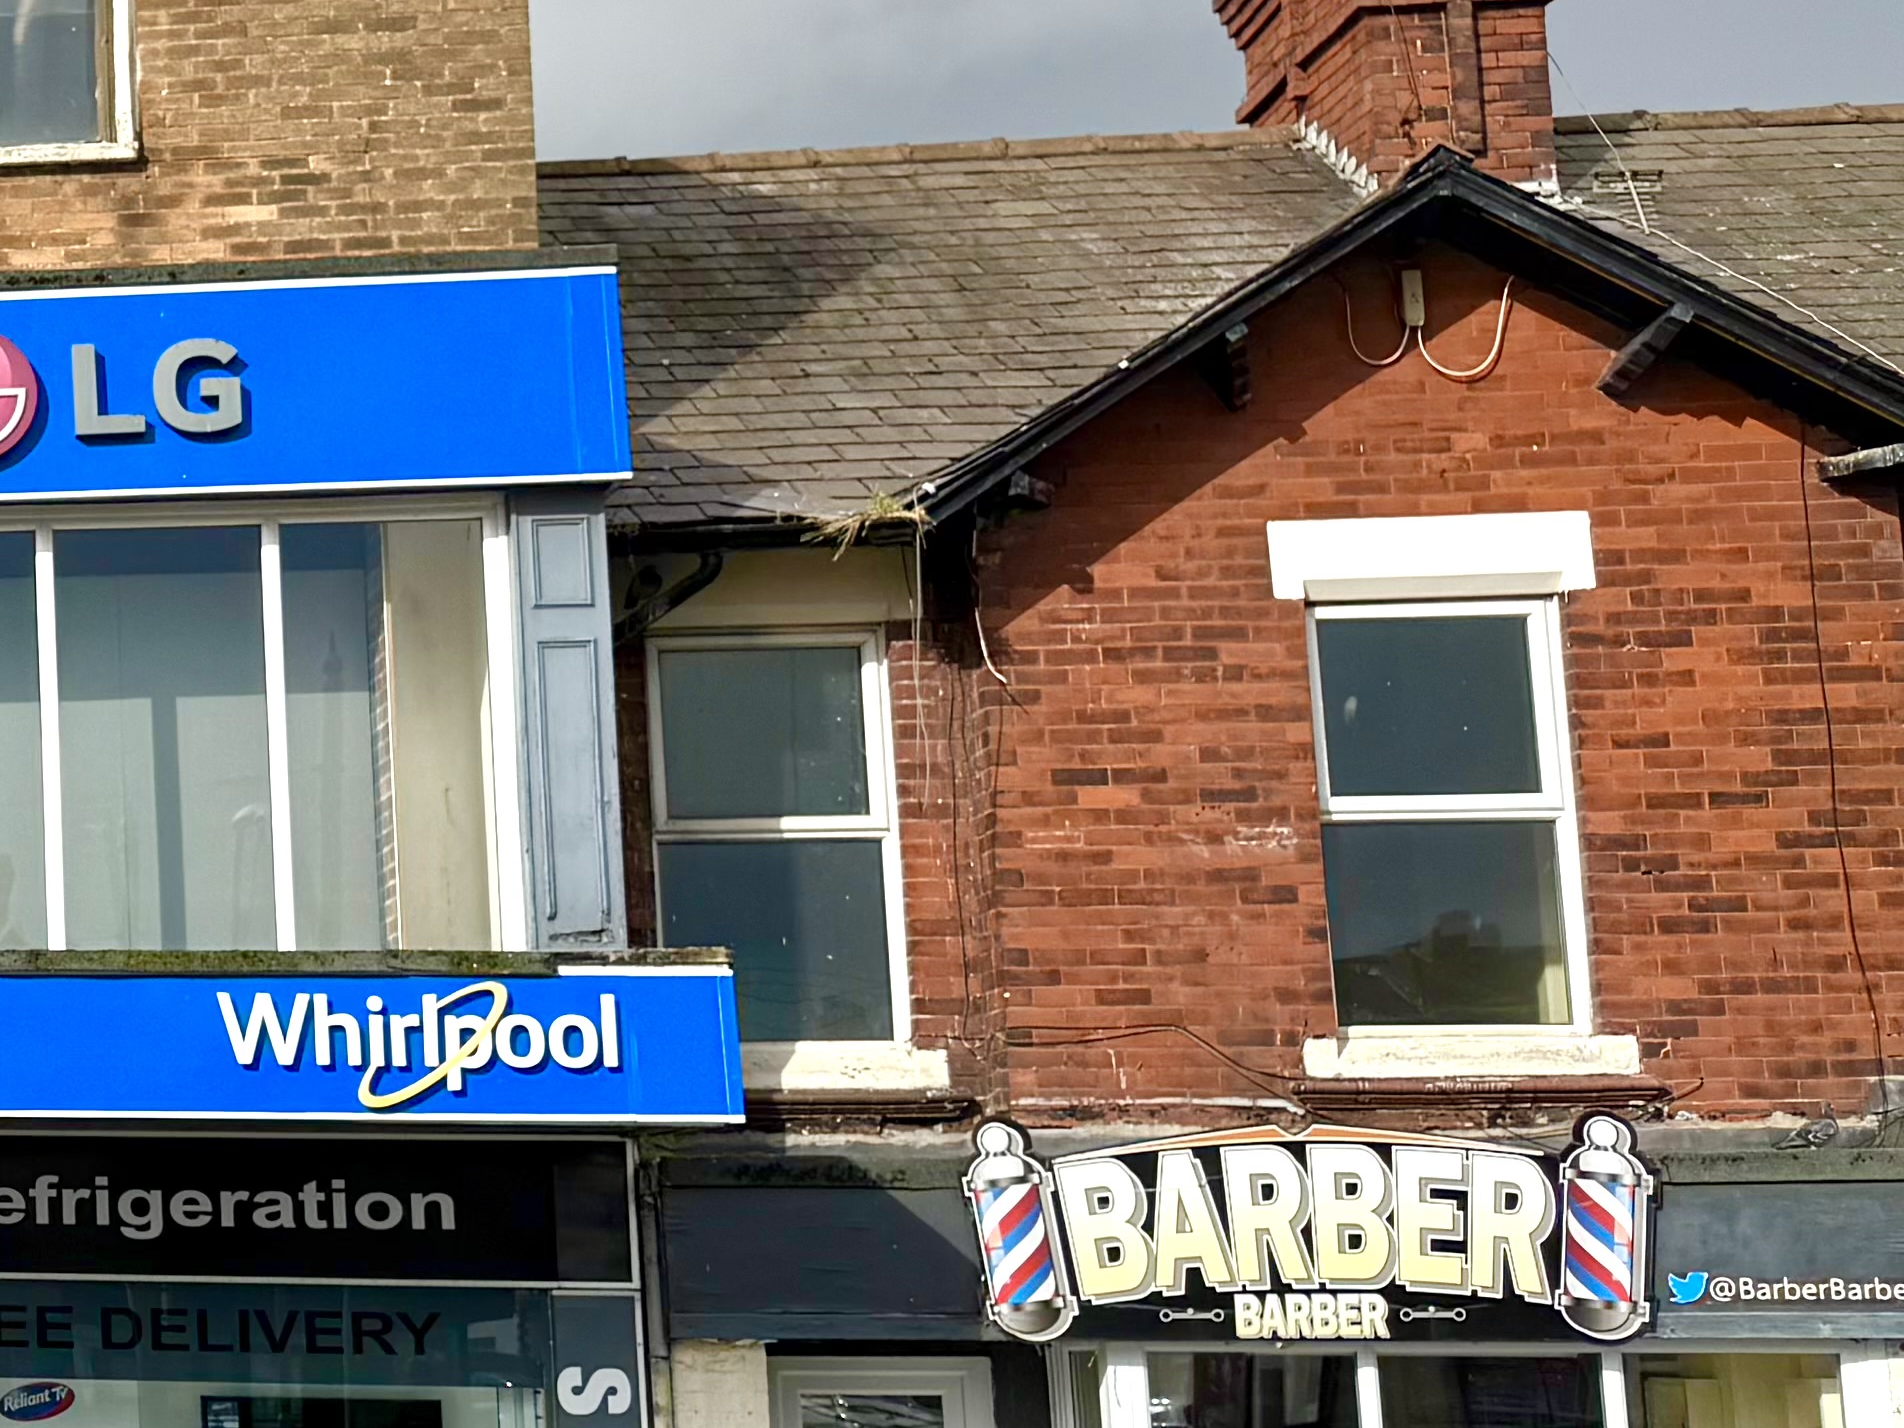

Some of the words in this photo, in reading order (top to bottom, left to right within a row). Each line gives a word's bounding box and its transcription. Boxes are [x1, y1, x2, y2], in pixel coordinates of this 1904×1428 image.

[71, 338, 243, 438] LG
[217, 988, 619, 1090] Whirlpool
[1053, 1141, 1560, 1304] BARBER
[100, 1306, 441, 1356] DELIVERY
[1233, 1293, 1391, 1339] BARBER
[4, 1389, 50, 1413] Reliant
